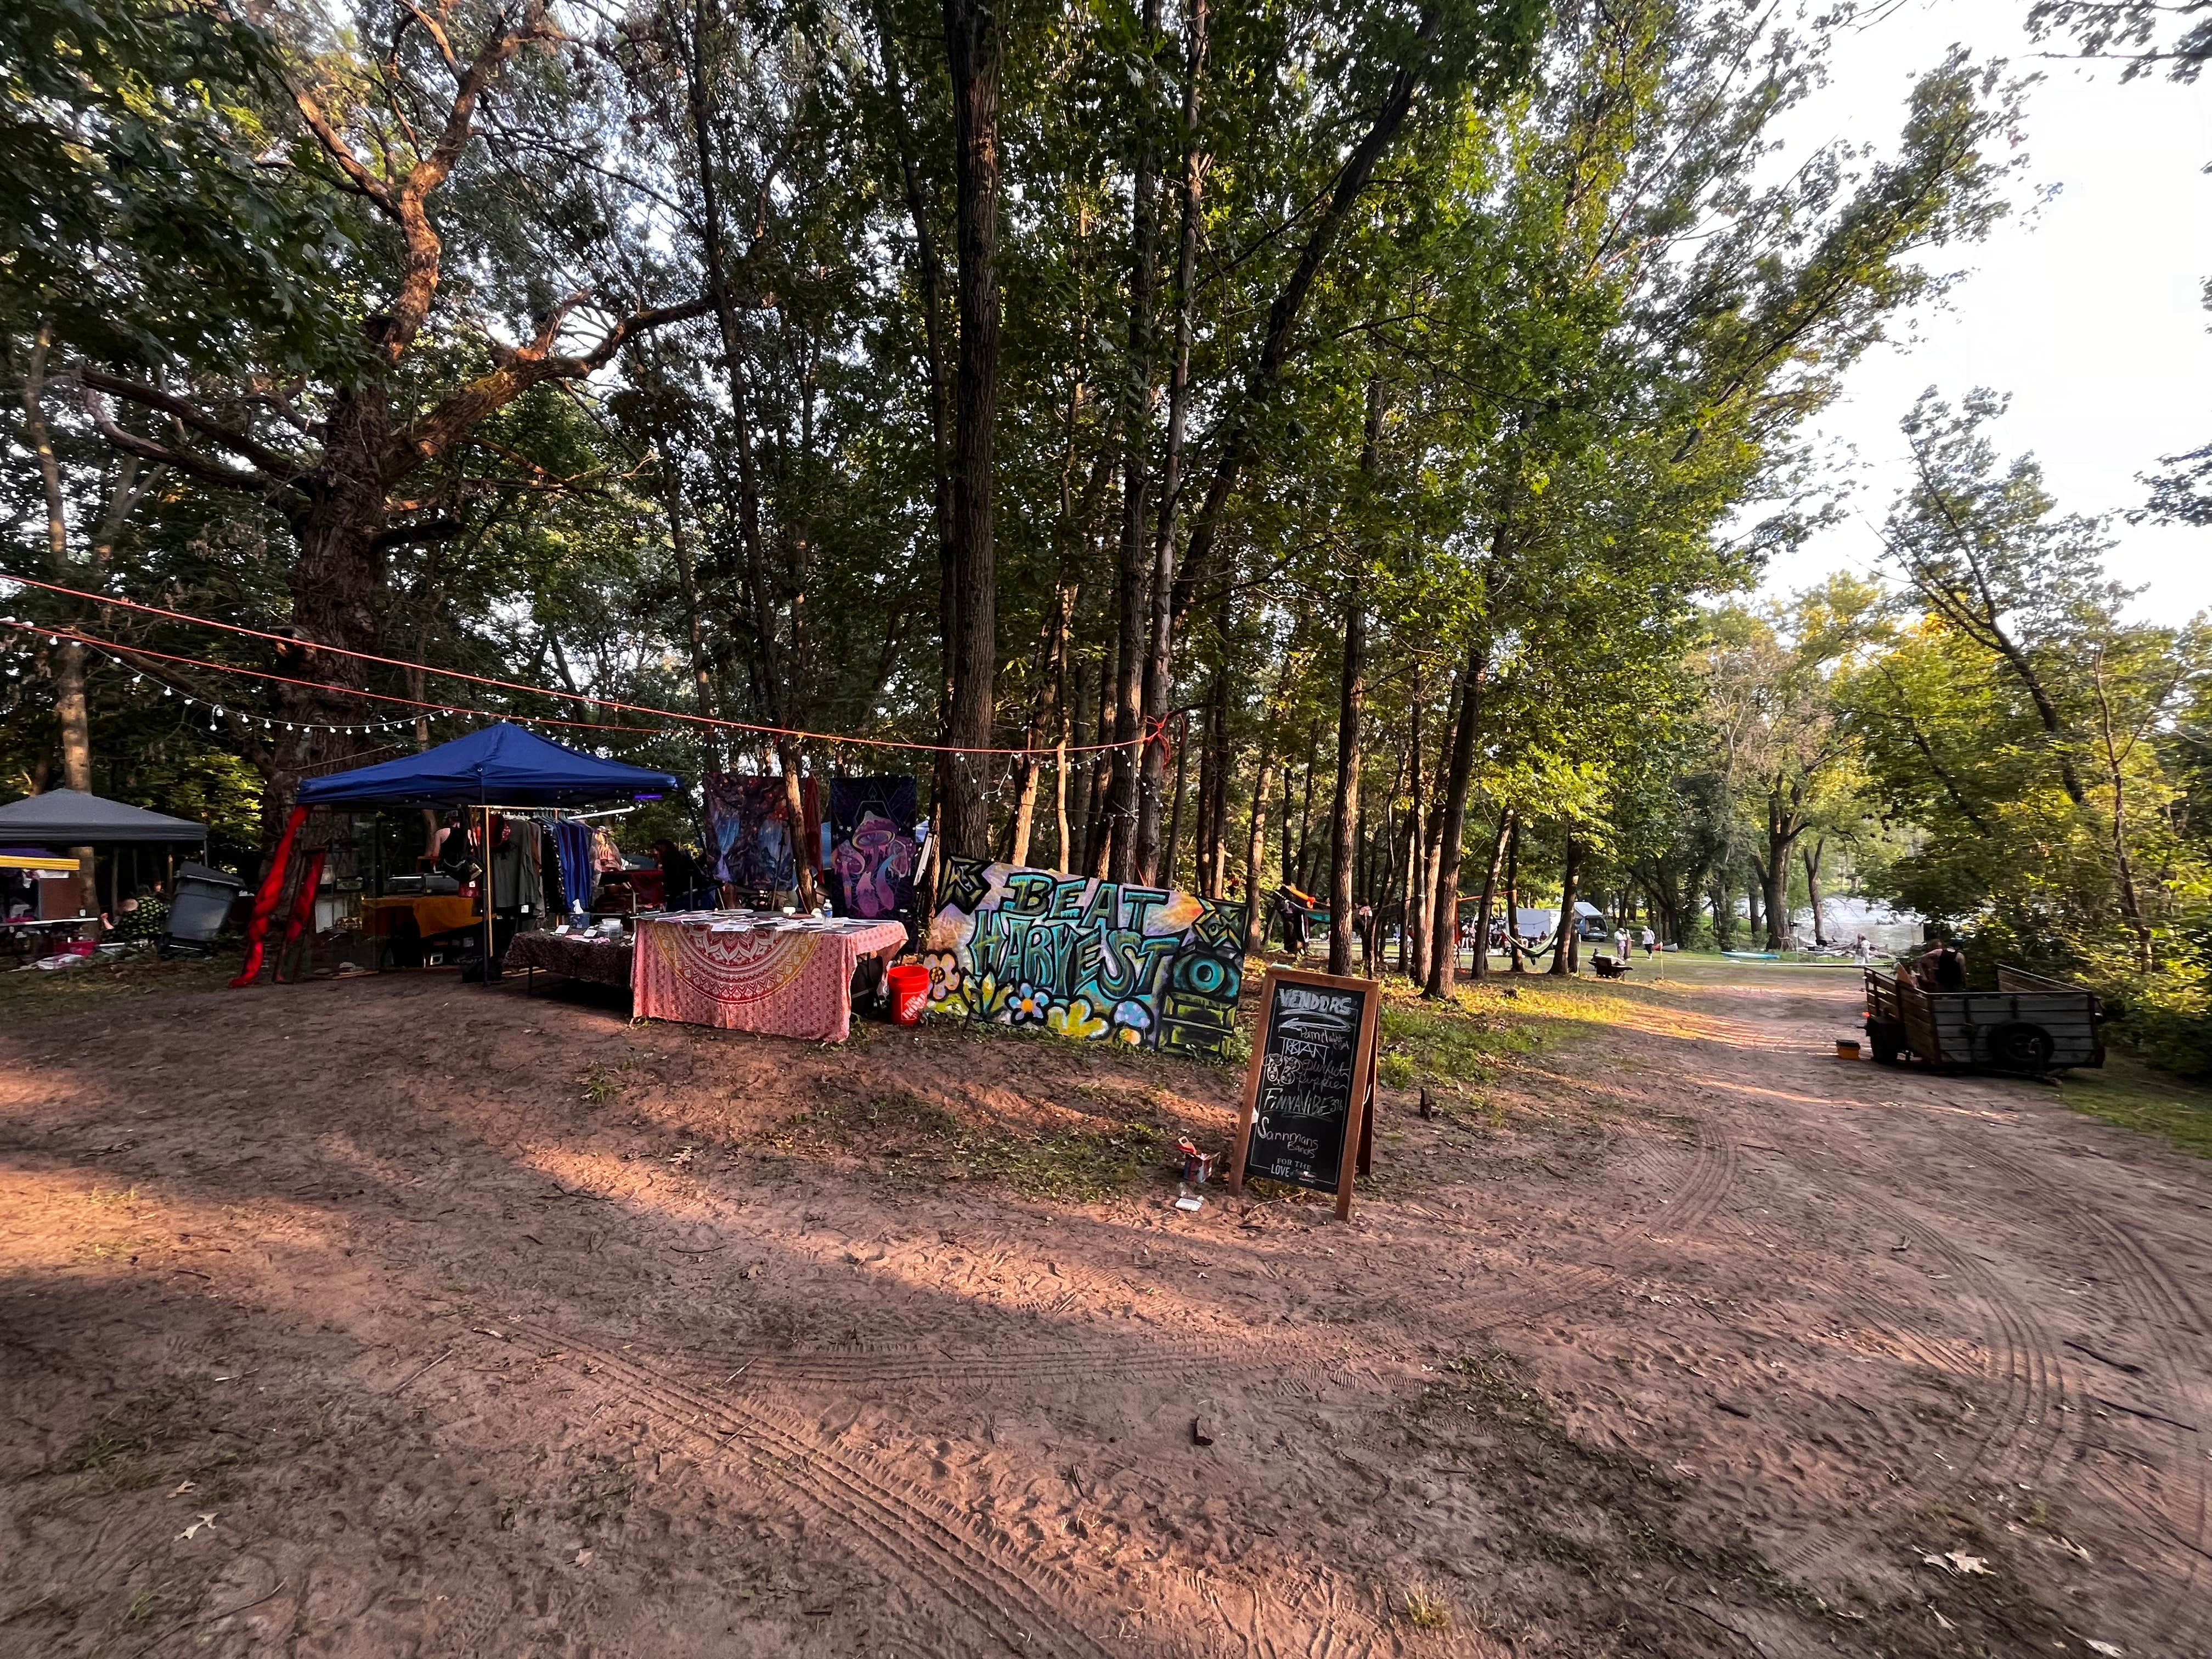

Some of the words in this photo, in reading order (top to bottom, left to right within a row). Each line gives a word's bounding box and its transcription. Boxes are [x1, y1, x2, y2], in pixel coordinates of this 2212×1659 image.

[1000, 871, 1170, 932] BEAT
[967, 909, 1182, 999] HARVEST
[1279, 989, 1352, 1015] VENDORS
[1330, 1099, 1343, 1113] 396
[1271, 1164, 1290, 1177] LOVE
[1295, 1160, 1312, 1171] THE
